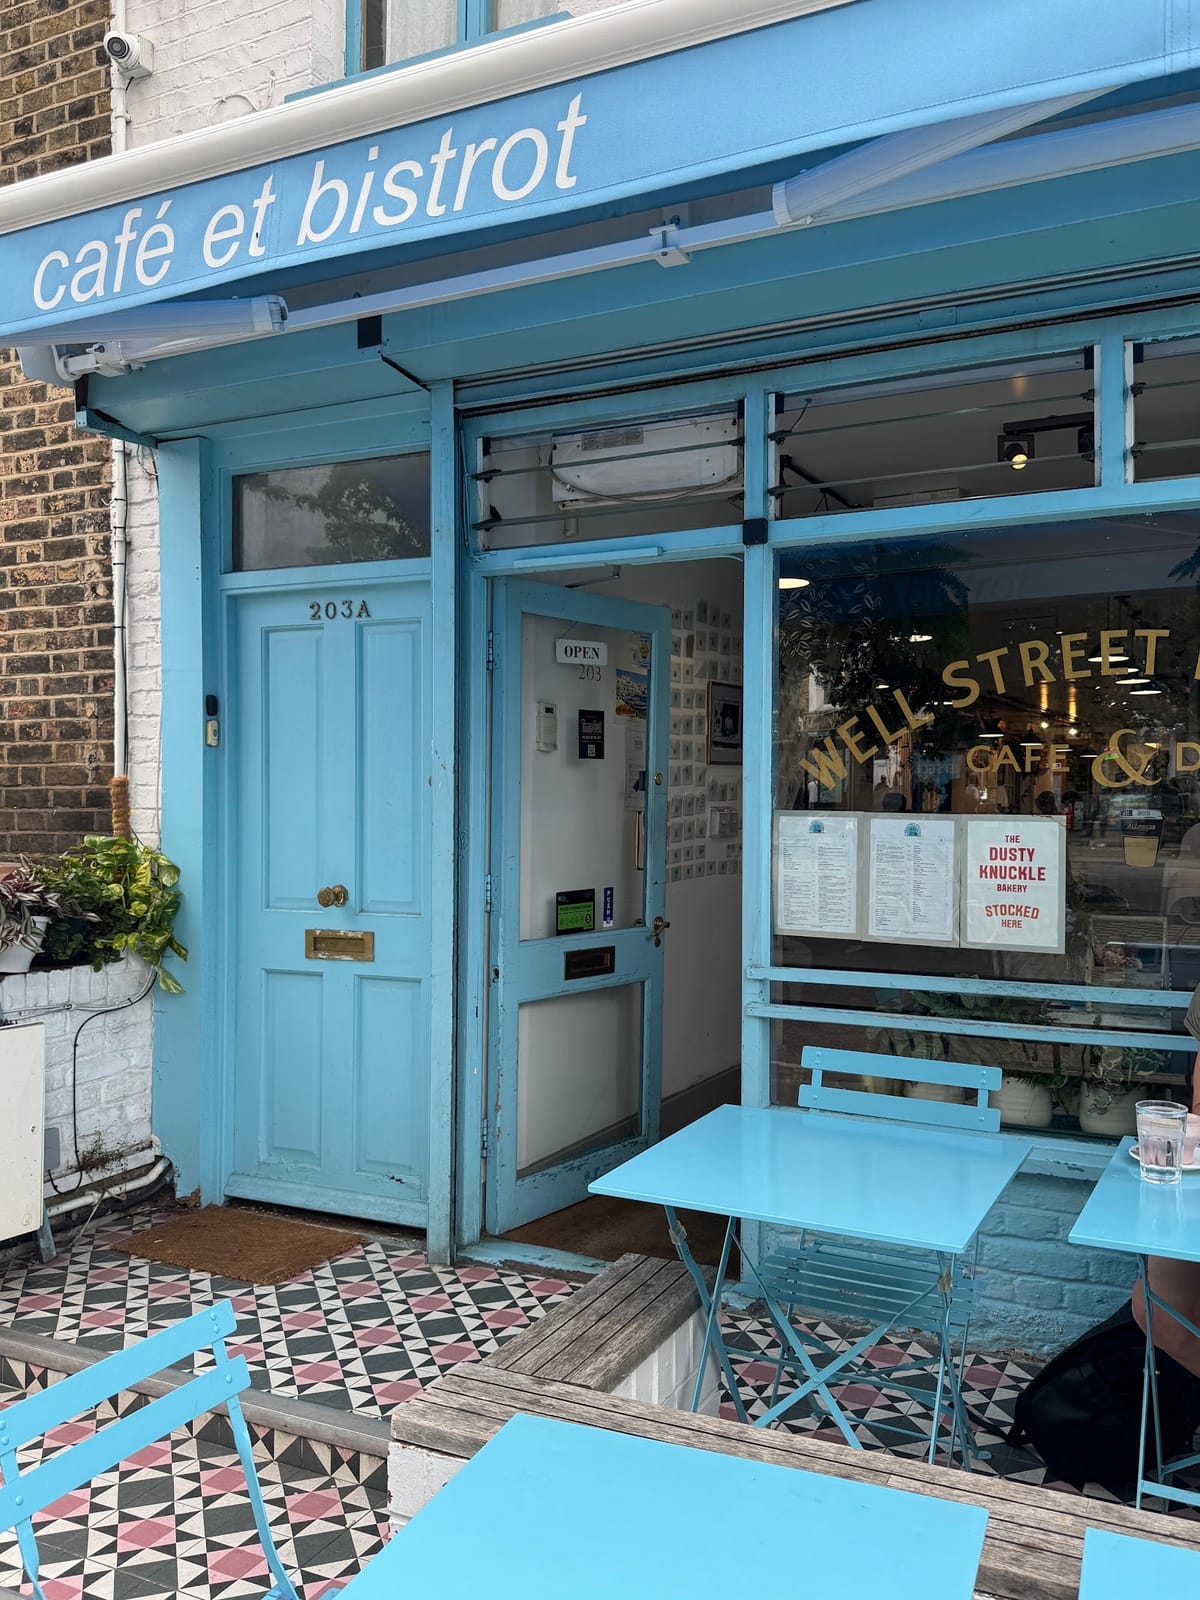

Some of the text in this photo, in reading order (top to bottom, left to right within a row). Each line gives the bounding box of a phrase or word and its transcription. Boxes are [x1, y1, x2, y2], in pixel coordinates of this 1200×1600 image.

[33, 92, 588, 310] café et bistrot
[309, 599, 371, 620] 203A
[564, 645, 600, 660] OPEN
[578, 664, 602, 682] 203
[799, 629, 1170, 791] WELL STREET
[966, 744, 1070, 773] CAFE
[1091, 728, 1162, 788] &
[1005, 835, 1020, 844] THE
[989, 847, 1035, 862] DUSTY
[979, 865, 1046, 881] KNUCKLE
[996, 884, 1027, 893] BAKERY
[985, 904, 1039, 919] STOCKED
[1001, 919, 1022, 928] HERE
